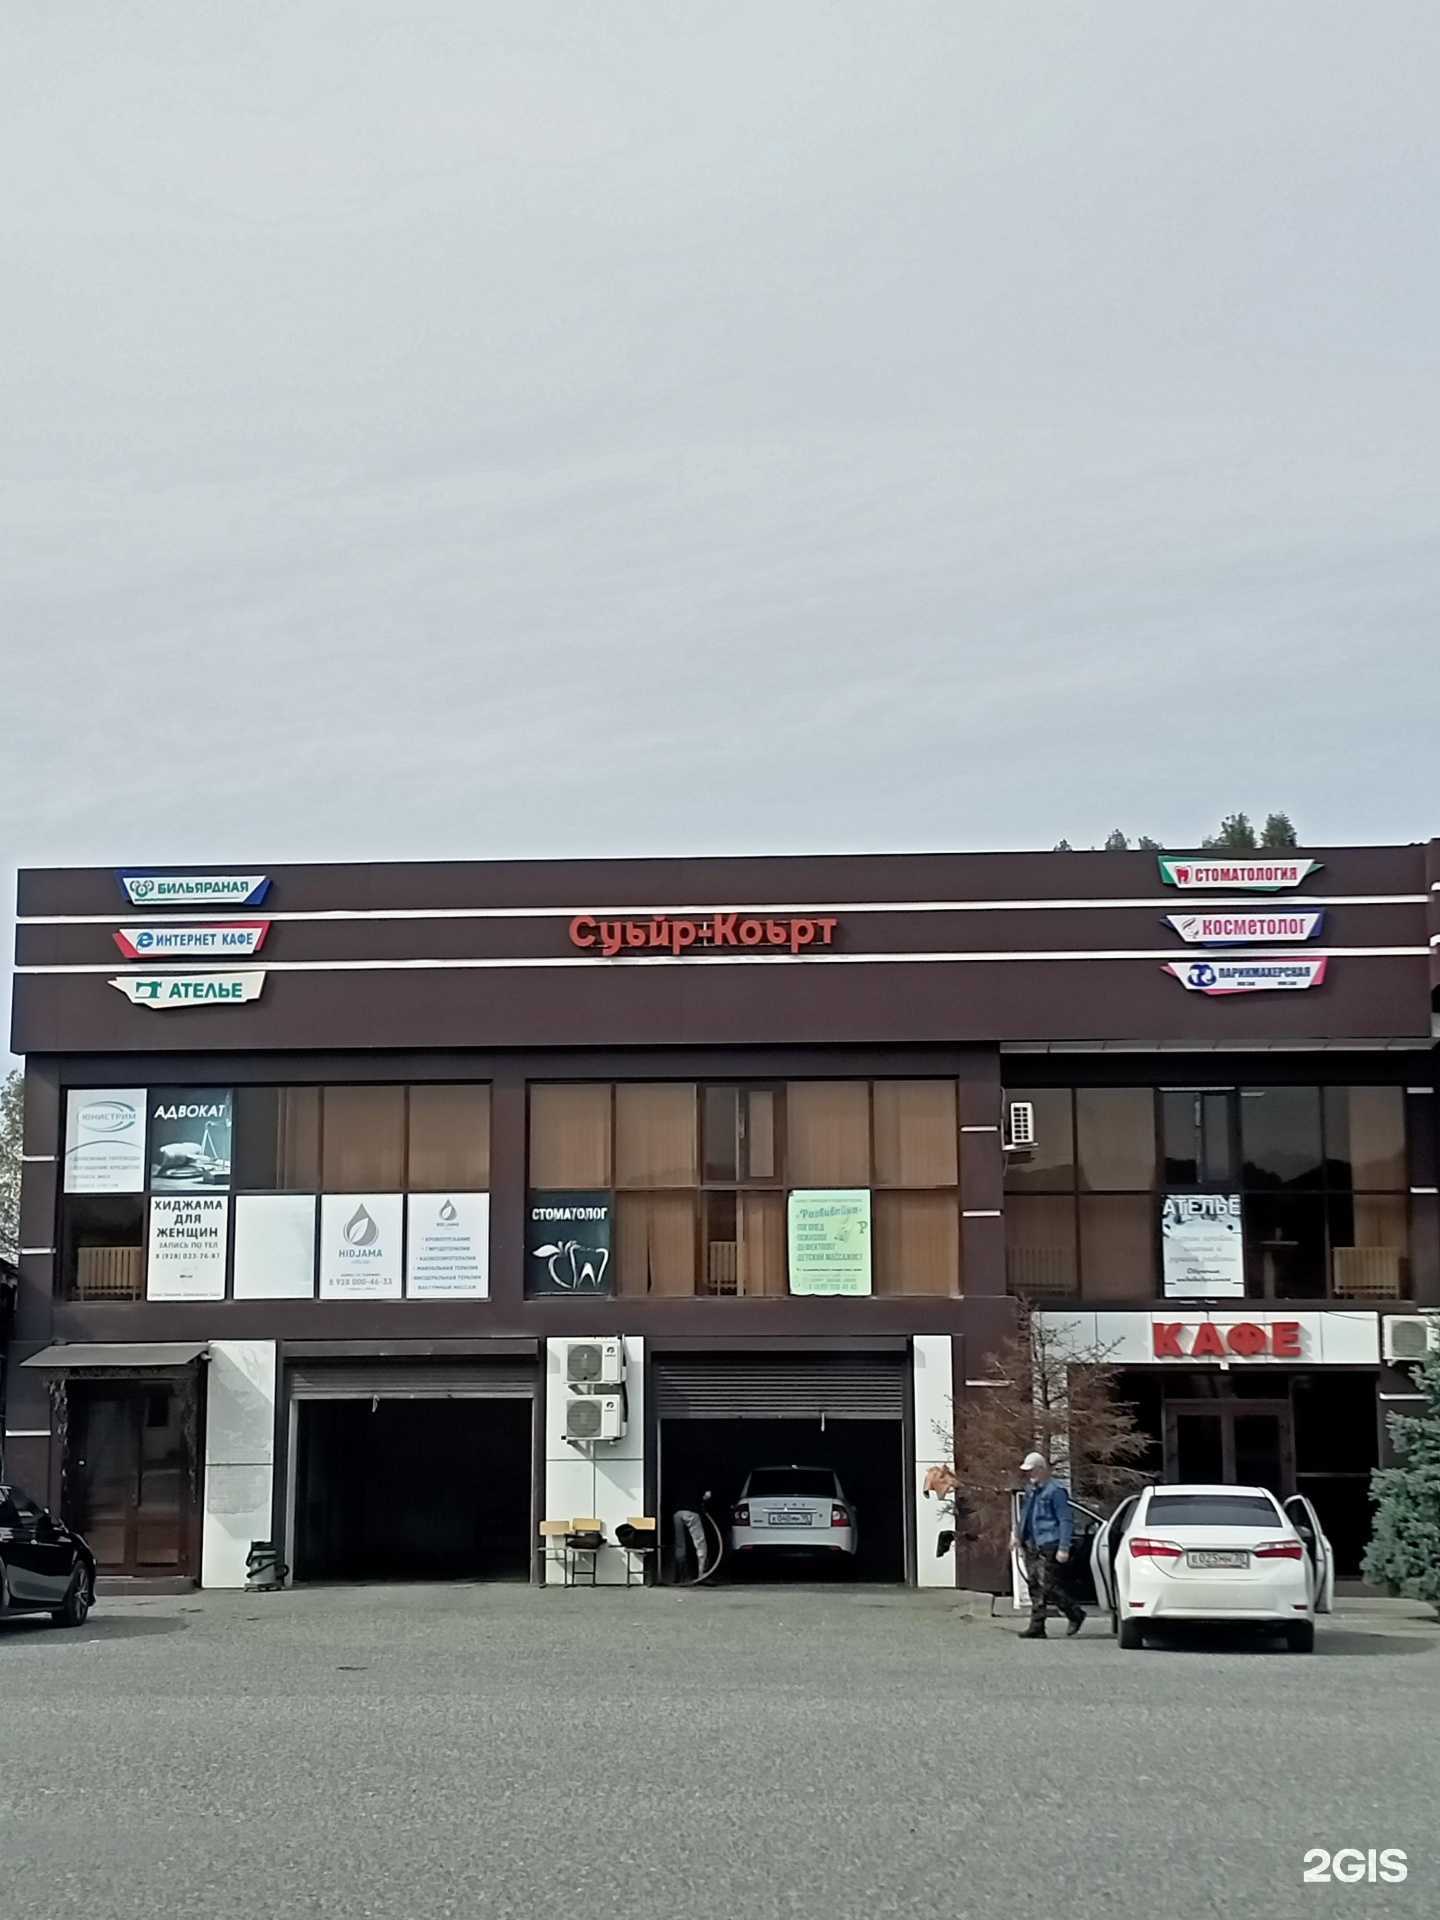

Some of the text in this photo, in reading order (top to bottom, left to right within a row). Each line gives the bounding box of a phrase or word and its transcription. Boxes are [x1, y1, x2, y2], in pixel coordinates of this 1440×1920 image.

[1195, 867, 1297, 882] СТОМАТОЛОГИЯ
[158, 881, 249, 894] БИЛЬЯРДНАЯ
[156, 934, 217, 946] ИНТЕРНЕТ
[222, 933, 253, 945] КАФЕ
[169, 983, 242, 998] АТЕЛЬЕ
[154, 1105, 225, 1119] АДВОКАТ
[154, 1200, 222, 1212] ХИДЖАМА
[1162, 1198, 1241, 1216] АТЕЛЬЕ
[174, 1214, 202, 1225] ДЛЯ
[532, 1208, 607, 1220] СТОМАТОЛОГ
[157, 1227, 218, 1240] ЖЕНЩИН
[338, 1249, 383, 1257] HIDJAMA
[1153, 1322, 1302, 1357] КАФЕ
